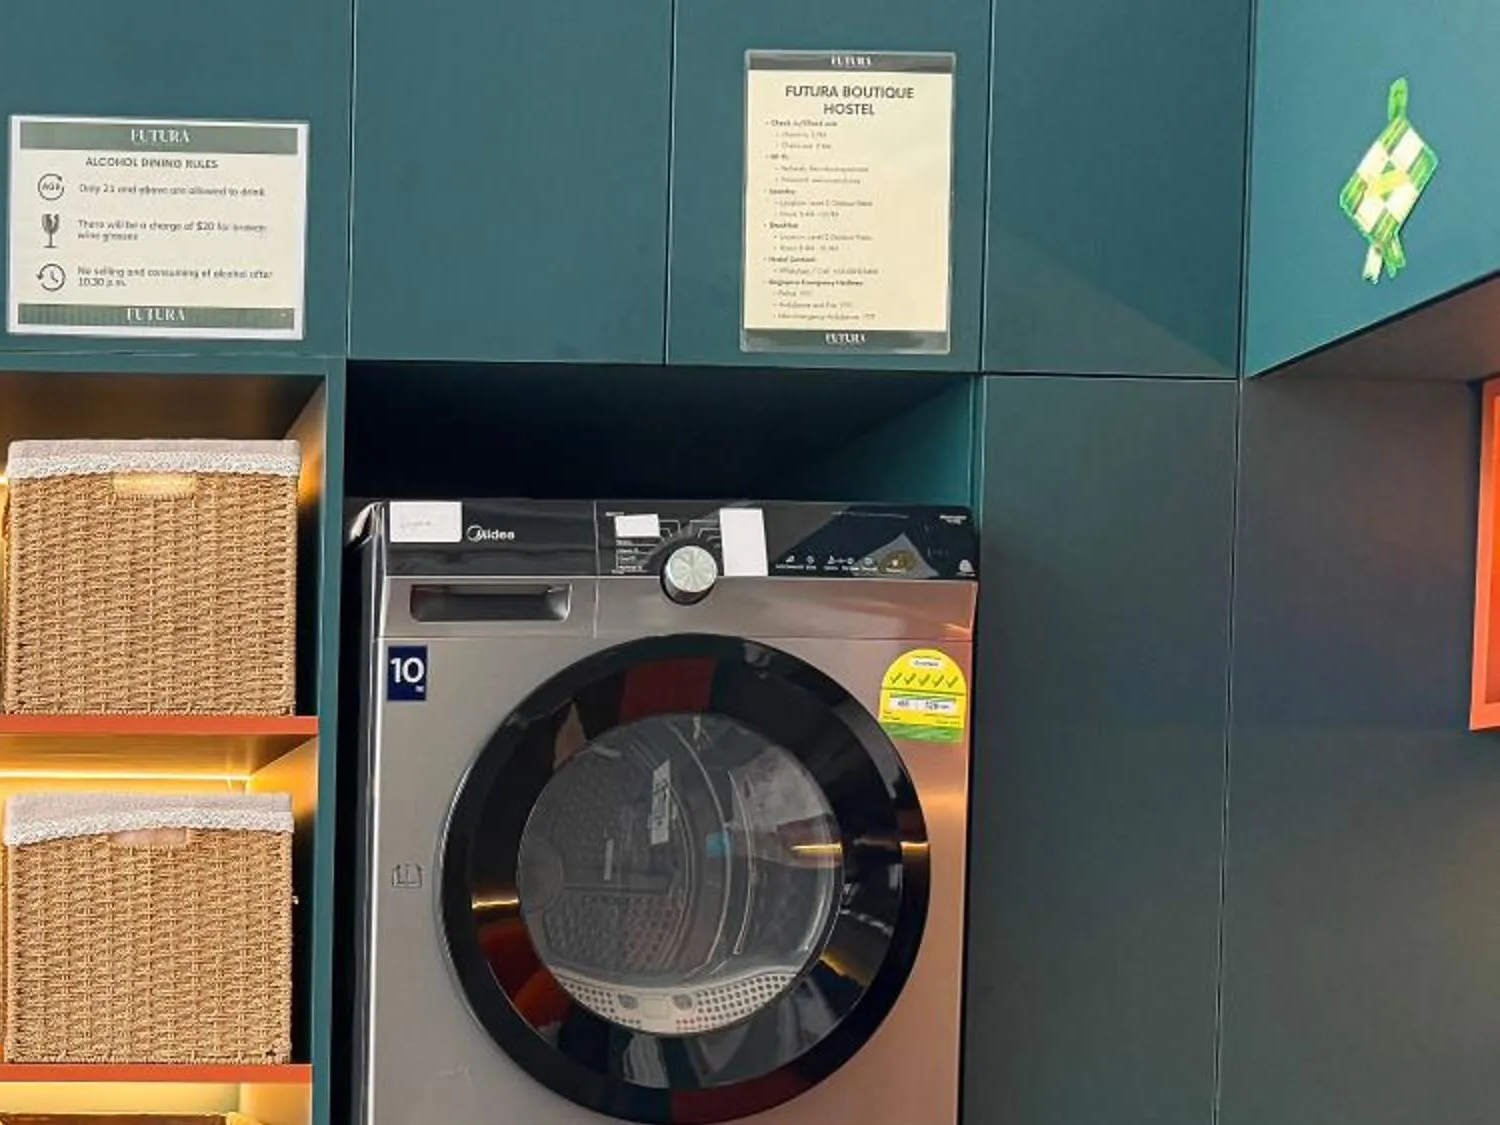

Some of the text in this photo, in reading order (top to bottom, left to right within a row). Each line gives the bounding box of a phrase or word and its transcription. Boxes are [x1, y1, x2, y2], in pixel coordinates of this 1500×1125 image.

[785, 85, 915, 99] FUTURA BOUTIQUE
[823, 103, 875, 116] HOSTEL
[131, 128, 190, 143] FUTURA
[86, 157, 219, 169] ALCOHOL DINING RULES
[79, 183, 101, 195] Only
[103, 184, 115, 193] 21
[118, 184, 137, 194] and
[78, 219, 104, 229] There
[149, 221, 182, 232] charge
[196, 221, 214, 231] $20
[127, 307, 185, 321] FUTURA
[473, 527, 515, 541] Midea
[390, 656, 425, 684] 10
